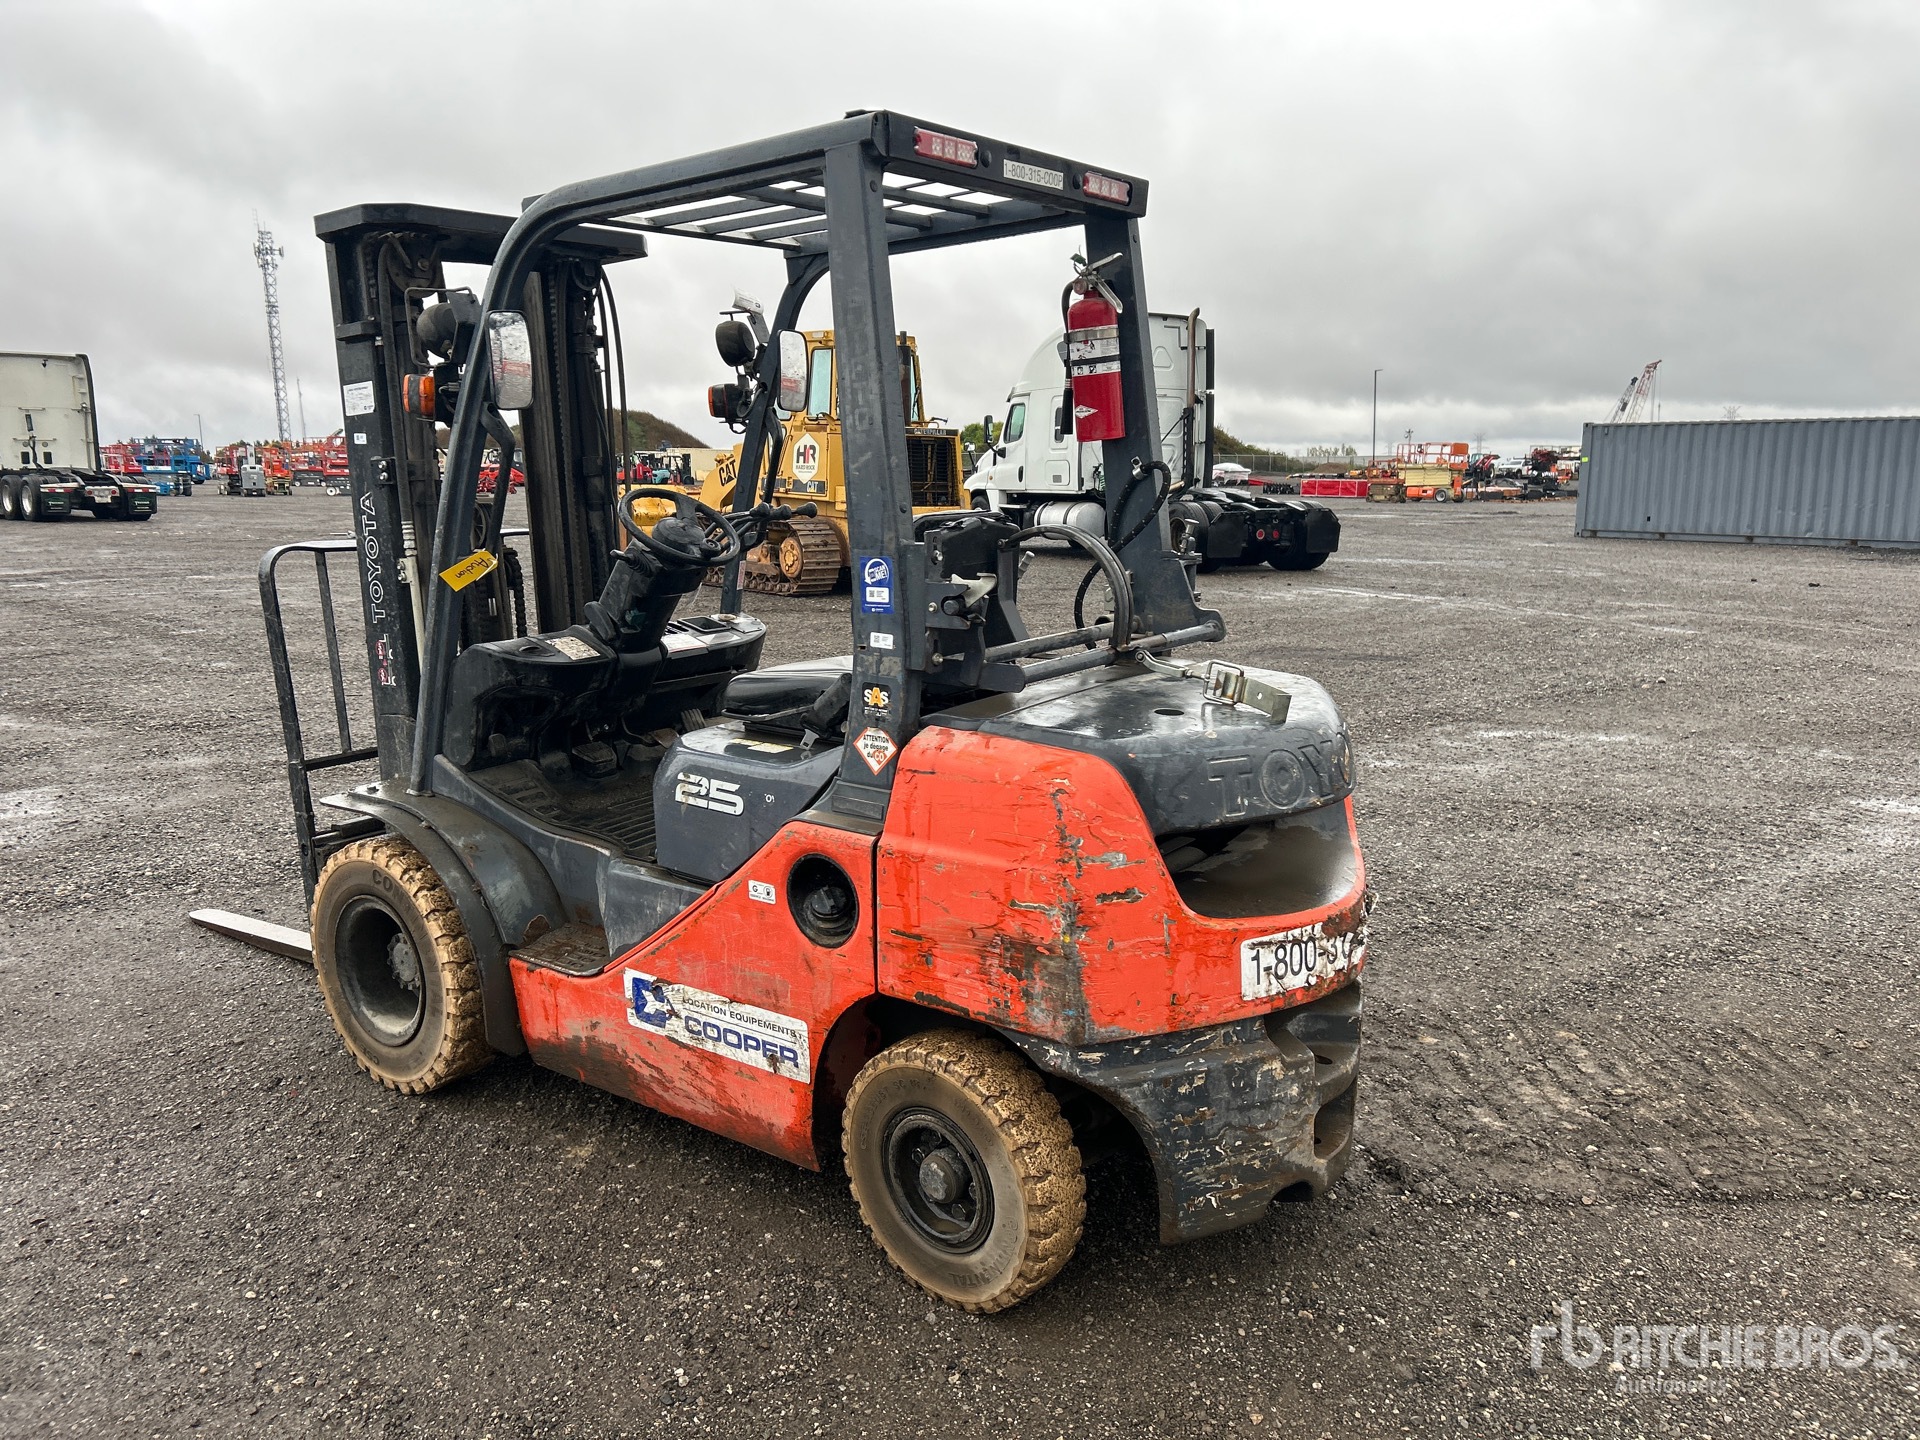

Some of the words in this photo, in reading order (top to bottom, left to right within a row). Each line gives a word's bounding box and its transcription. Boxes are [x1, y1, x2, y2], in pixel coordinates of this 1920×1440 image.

[1004, 162, 1063, 188] 1-800-315-COOP
[796, 444, 817, 464] HR
[718, 459, 737, 487] CAT
[806, 481, 819, 493] CAT
[360, 491, 387, 624] TOYOTA
[863, 686, 889, 707] SAS
[863, 734, 890, 744] ATTENTION
[674, 771, 744, 817] 25
[682, 996, 727, 1017] LOCATION
[684, 1015, 799, 1069] COOPER
